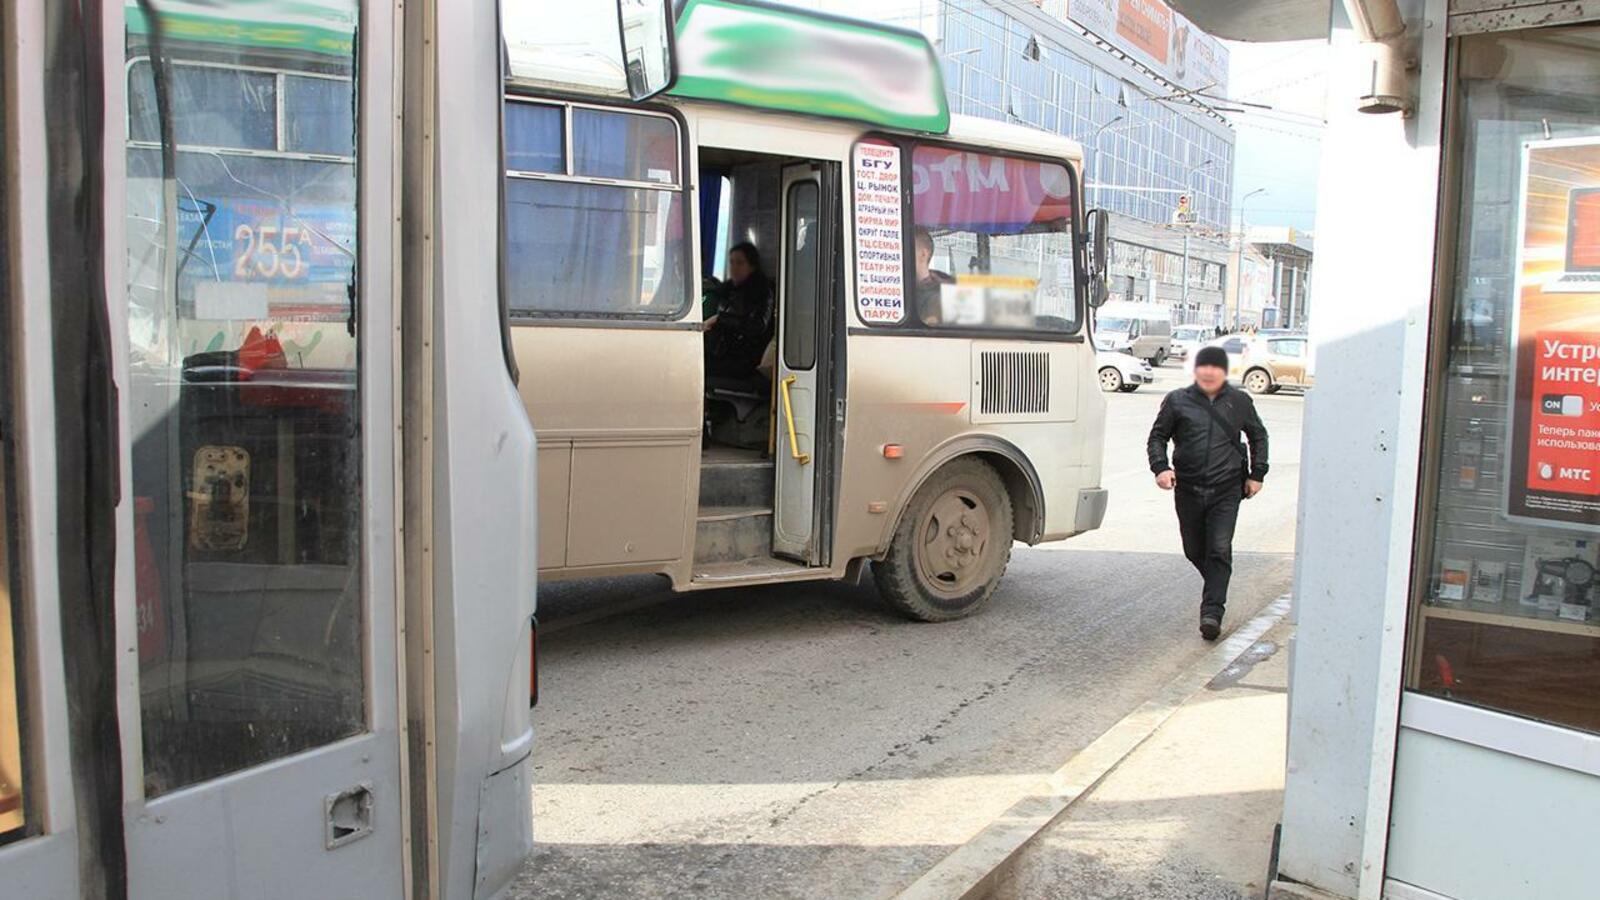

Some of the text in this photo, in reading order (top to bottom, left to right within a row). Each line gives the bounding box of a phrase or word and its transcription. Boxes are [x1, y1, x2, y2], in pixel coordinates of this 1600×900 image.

[862, 159, 892, 169] БГУ
[868, 182, 898, 193] РЫНОК
[859, 250, 900, 261] СПОРТИВНАЯ
[860, 261, 900, 273] ТЕАТР НУР
[860, 298, 901, 308] О'КЕЙ
[864, 310, 899, 320] ПАРУС
[1543, 339, 1600, 363] Устр
[1544, 400, 1560, 409] ON
[1538, 424, 1576, 438] Теперь
[1560, 467, 1591, 481] МТС
